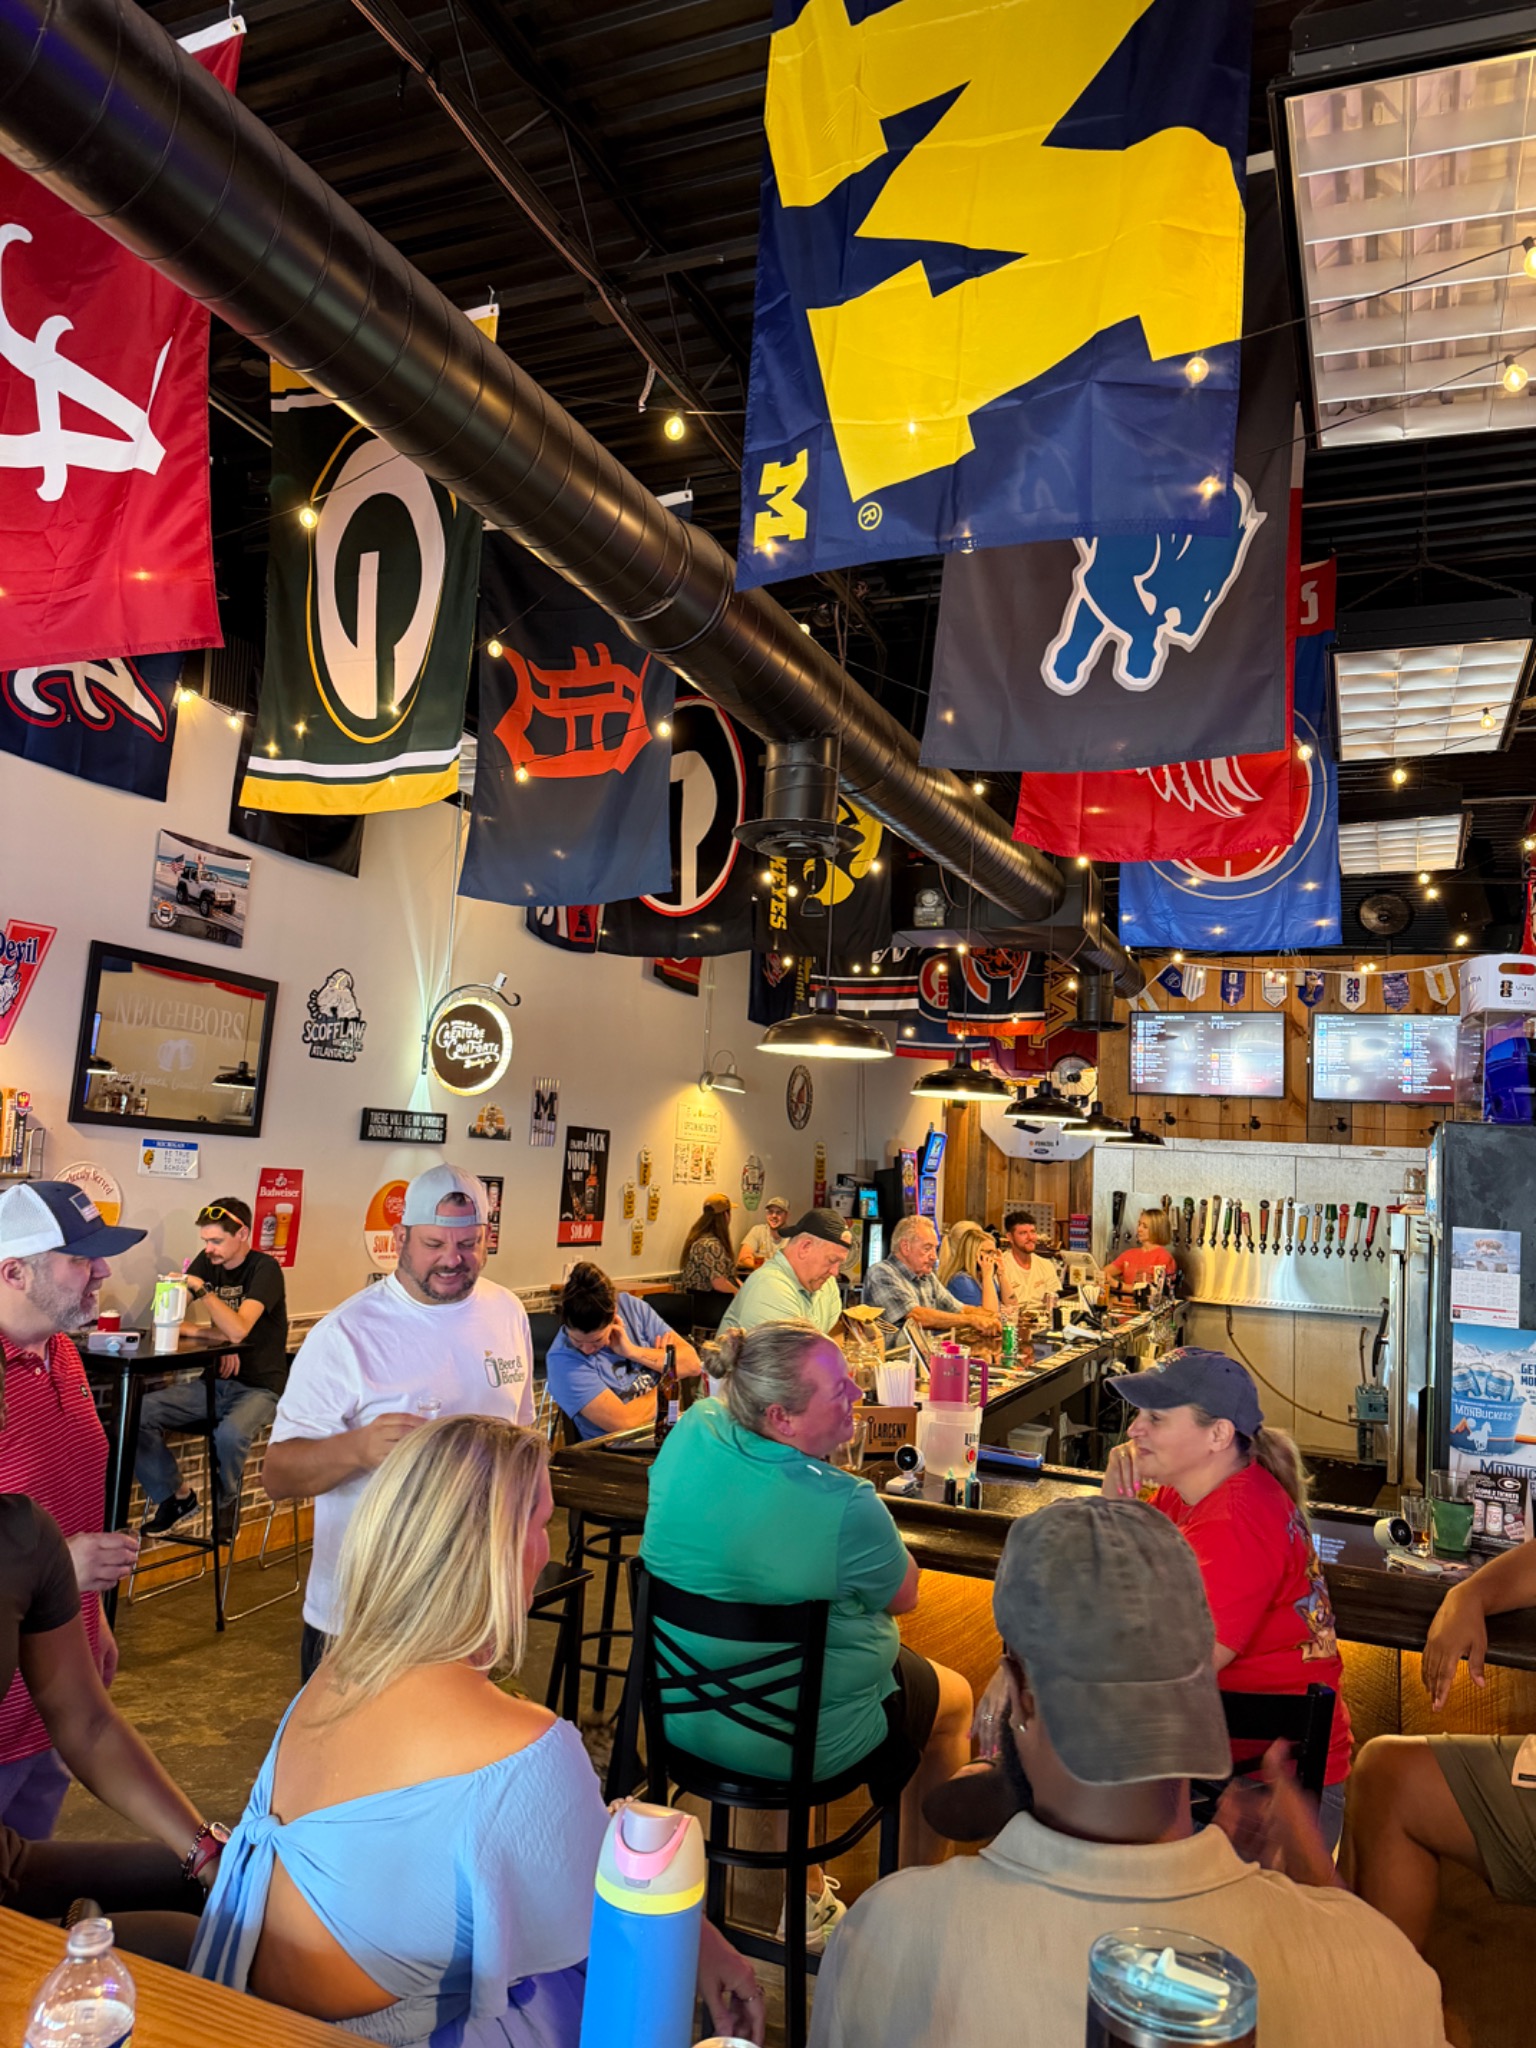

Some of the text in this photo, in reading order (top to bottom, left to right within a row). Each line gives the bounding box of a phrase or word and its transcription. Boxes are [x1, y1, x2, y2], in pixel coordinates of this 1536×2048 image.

[754, 448, 808, 547] M
[1347, 978, 1360, 990] 20
[1346, 991, 1359, 1003] 26
[111, 990, 245, 1042] NEIGHBORS
[303, 1021, 366, 1041] SCOFFLAW
[534, 1089, 558, 1121] M
[584, 1132, 606, 1152] JACK
[567, 1150, 590, 1171] YOUR
[260, 1186, 300, 1198] Budweiser
[498, 1357, 515, 1371] Beer
[873, 1423, 908, 1439] LARCENY
